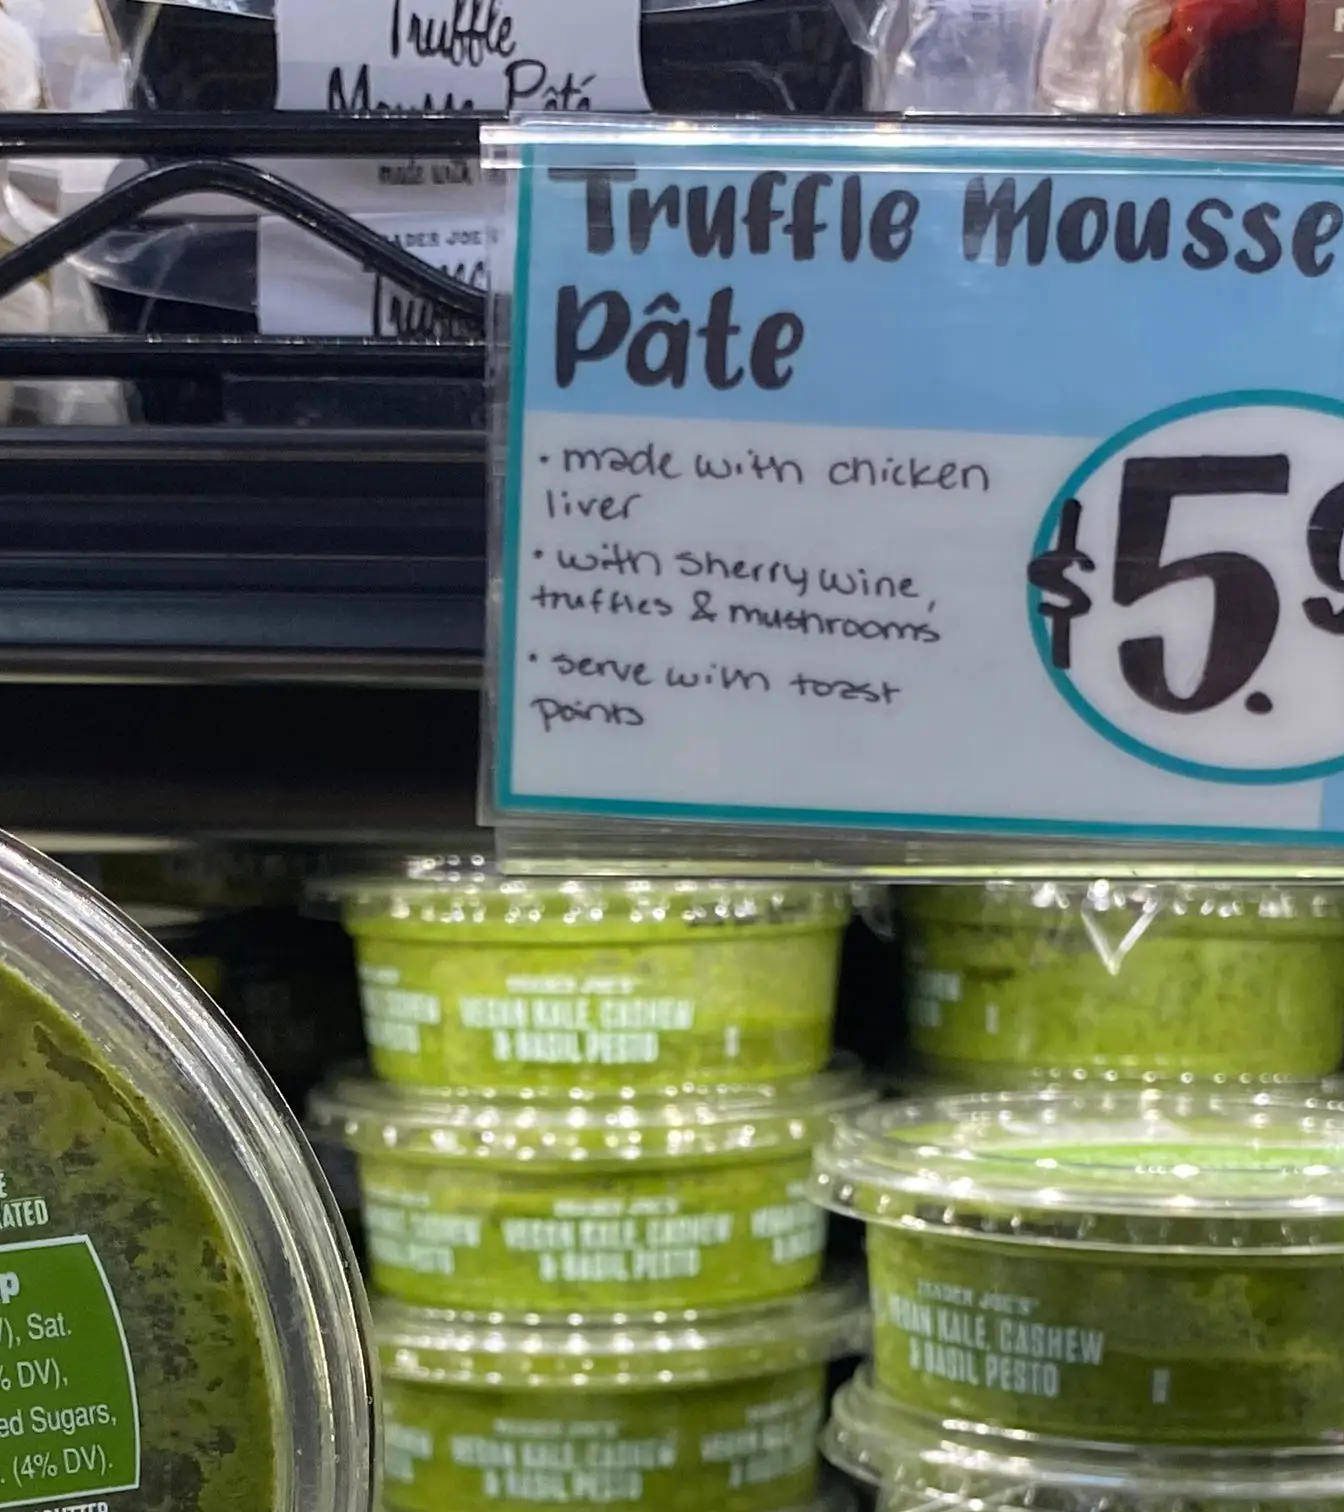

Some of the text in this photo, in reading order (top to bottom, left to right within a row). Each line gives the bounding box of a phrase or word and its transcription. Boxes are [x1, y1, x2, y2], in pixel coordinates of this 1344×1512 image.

[548, 167, 1344, 278] Truffle Mousse
[563, 443, 990, 492] made with chicken
[546, 489, 641, 521] liver
[558, 543, 662, 577] with
[675, 549, 810, 595] sherry
[691, 590, 718, 623] &
[730, 604, 941, 644] mushrooms
[551, 653, 653, 687] serve
[790, 672, 901, 704] toast
[27, 1313, 72, 1342] Sat.
